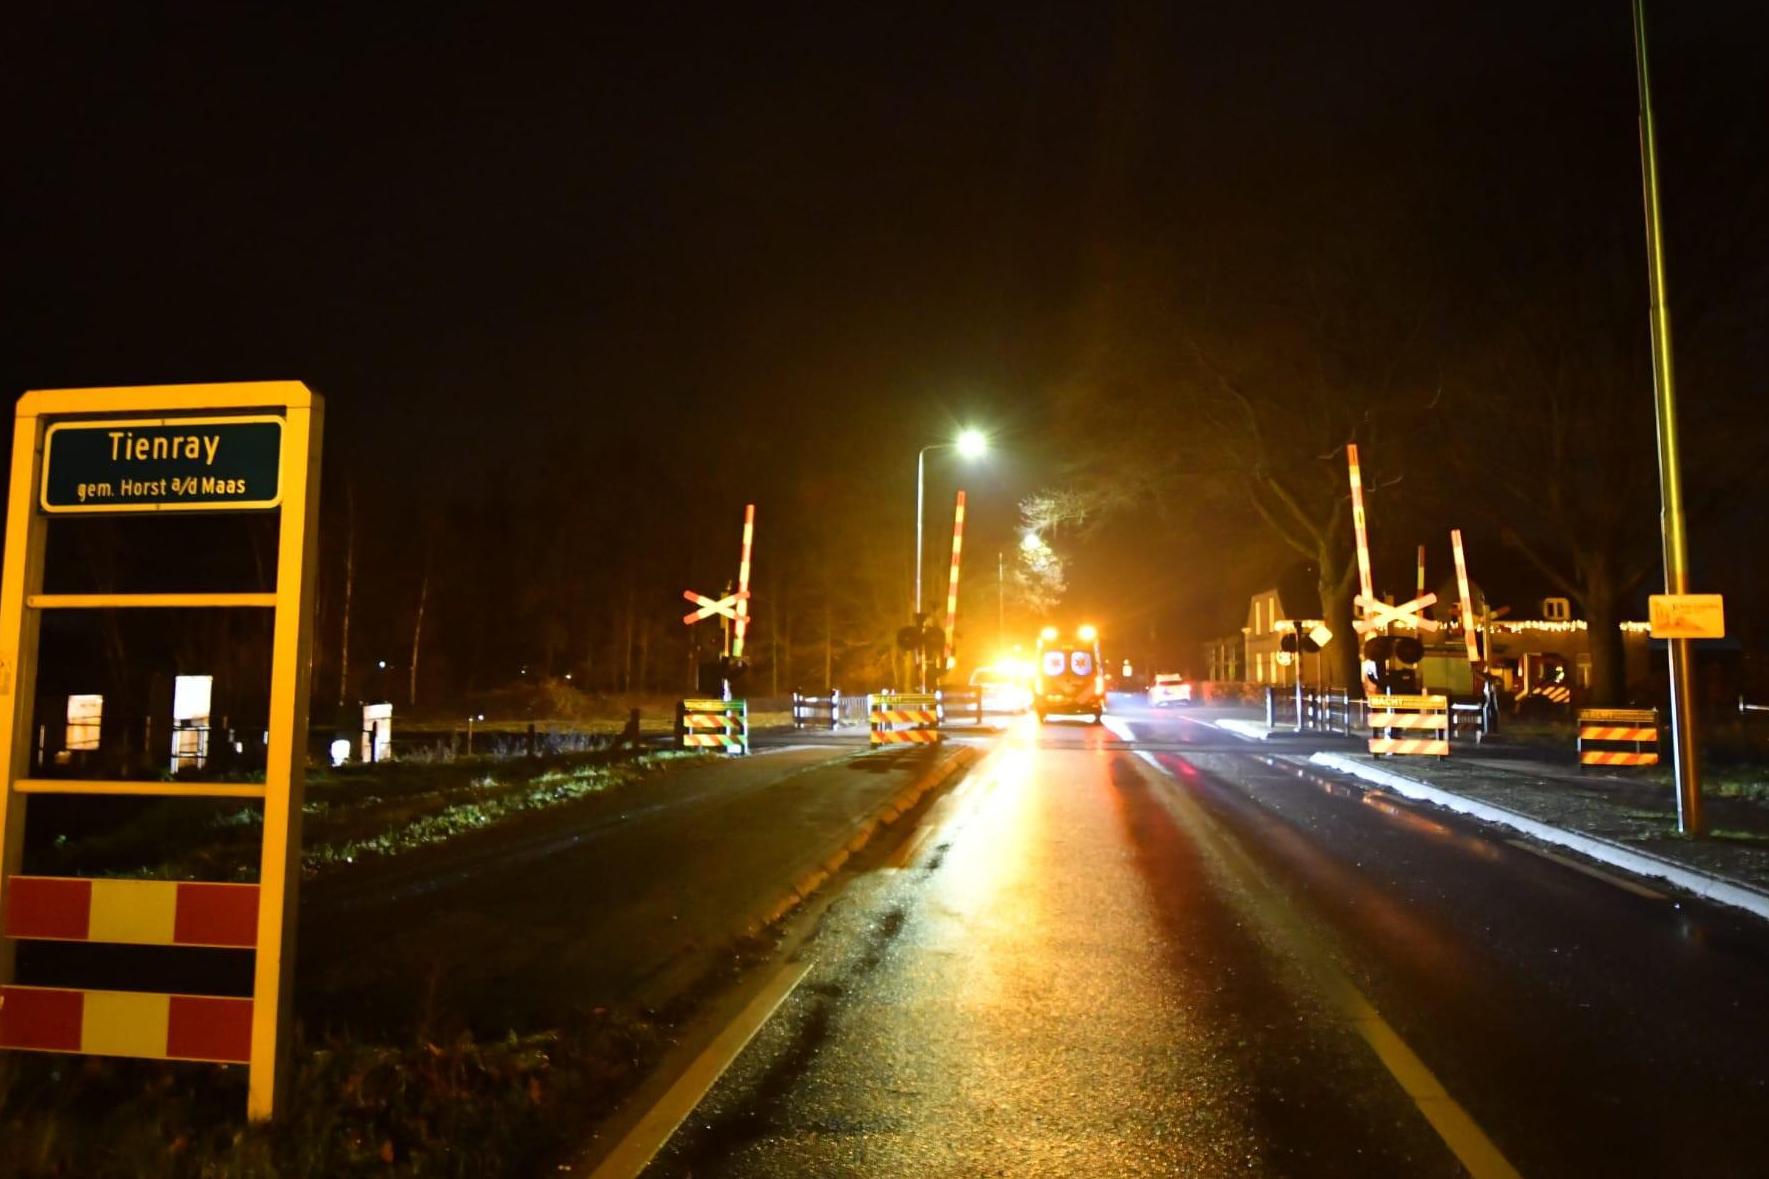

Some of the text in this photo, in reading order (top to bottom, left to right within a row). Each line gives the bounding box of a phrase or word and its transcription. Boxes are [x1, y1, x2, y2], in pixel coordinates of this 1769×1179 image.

[108, 432, 220, 465] Tienray
[77, 476, 246, 502] gem. Horst a/d Maas
